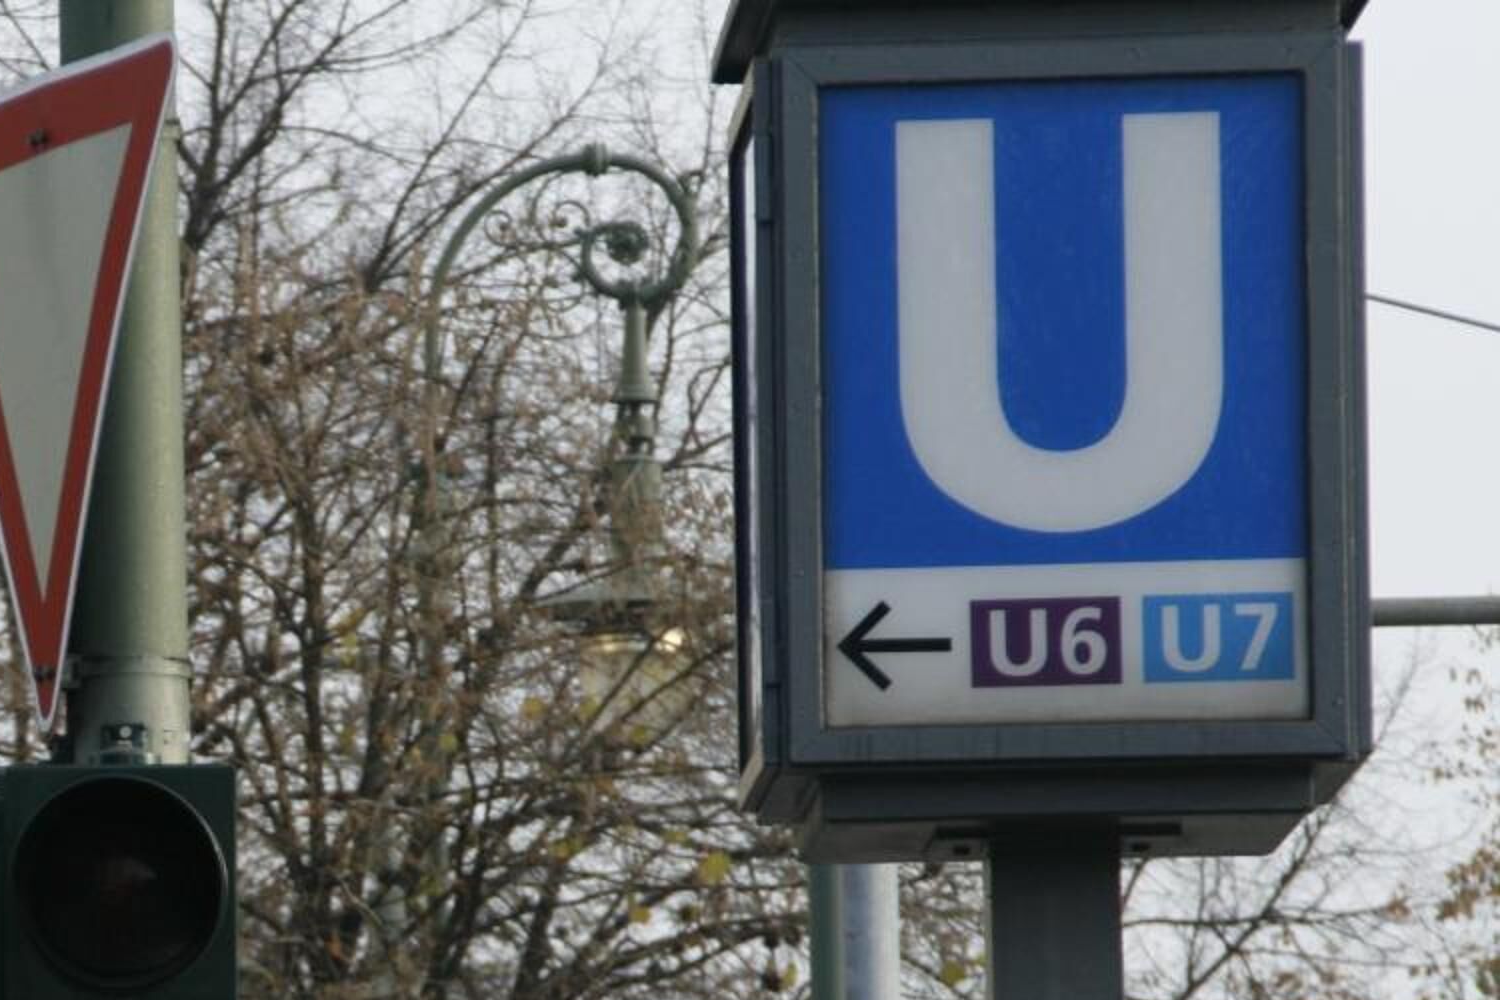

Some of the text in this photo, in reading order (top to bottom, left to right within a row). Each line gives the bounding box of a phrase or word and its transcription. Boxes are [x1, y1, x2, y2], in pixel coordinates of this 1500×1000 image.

[895, 111, 1224, 533] U
[988, 601, 1278, 678] U6 U7
